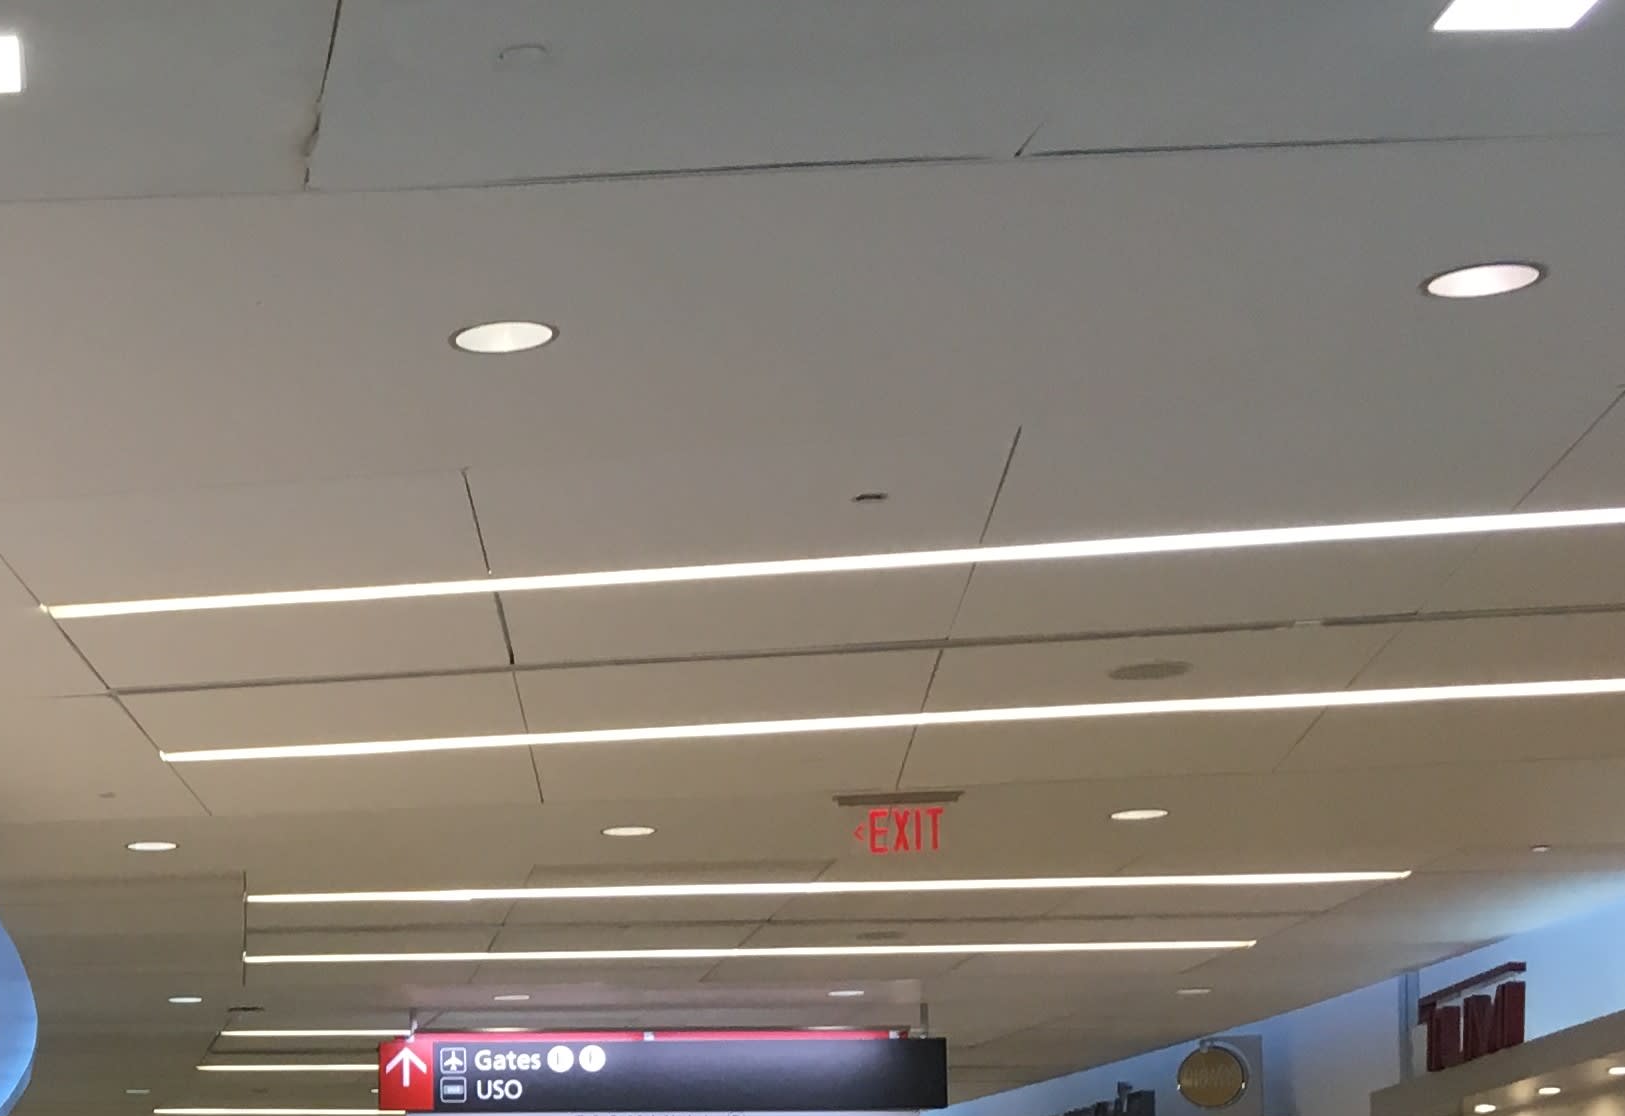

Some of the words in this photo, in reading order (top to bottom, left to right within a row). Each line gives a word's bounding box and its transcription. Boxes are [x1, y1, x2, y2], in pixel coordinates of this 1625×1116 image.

[868, 806, 945, 855] EXIT
[474, 1049, 542, 1072] Gates
[476, 1079, 523, 1100] USO
